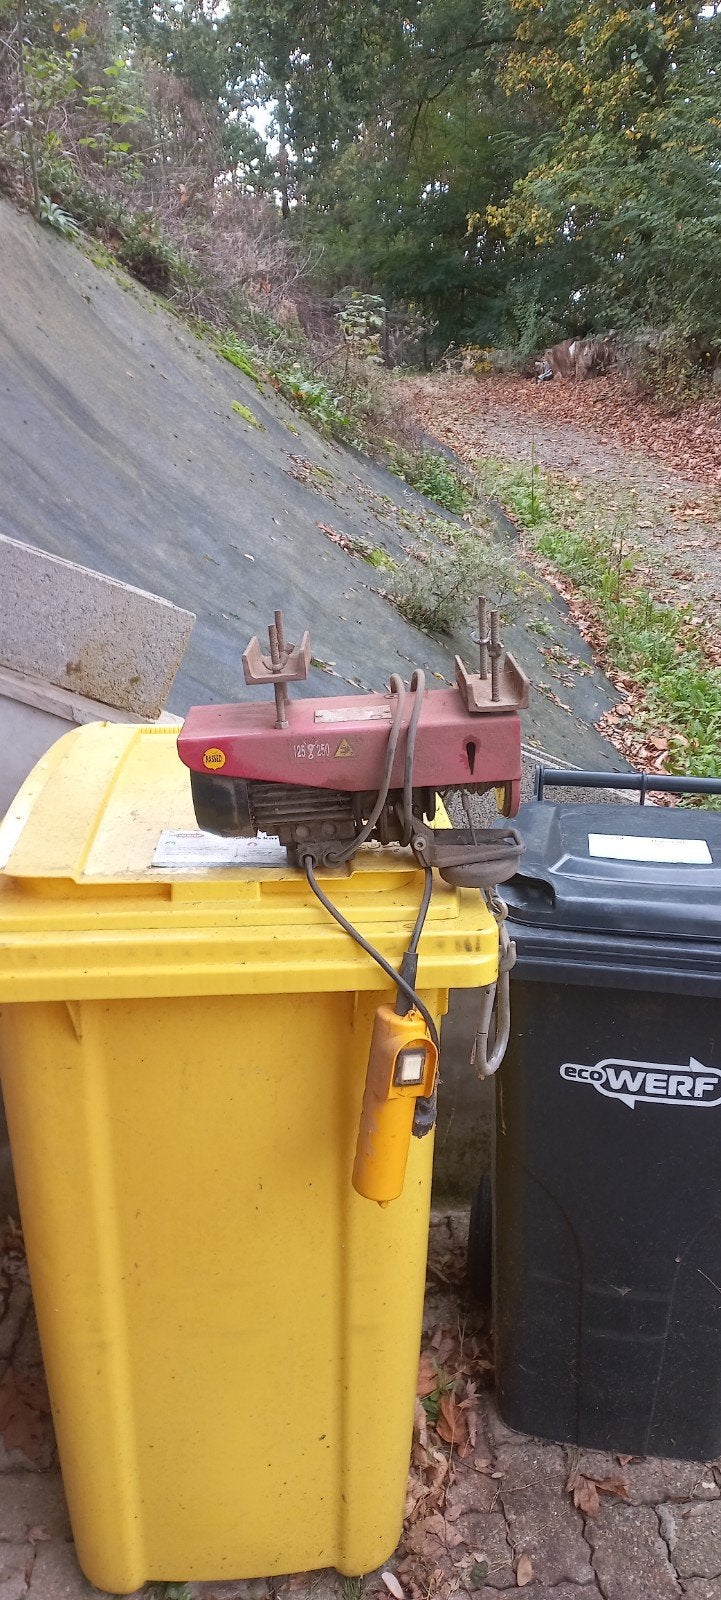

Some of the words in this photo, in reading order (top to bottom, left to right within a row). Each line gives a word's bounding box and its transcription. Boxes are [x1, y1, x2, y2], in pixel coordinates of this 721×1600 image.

[293, 743, 306, 758] 125
[316, 743, 330, 757] 250
[205, 754, 223, 763] PASSED
[563, 1066, 719, 1098] ecoWERF
